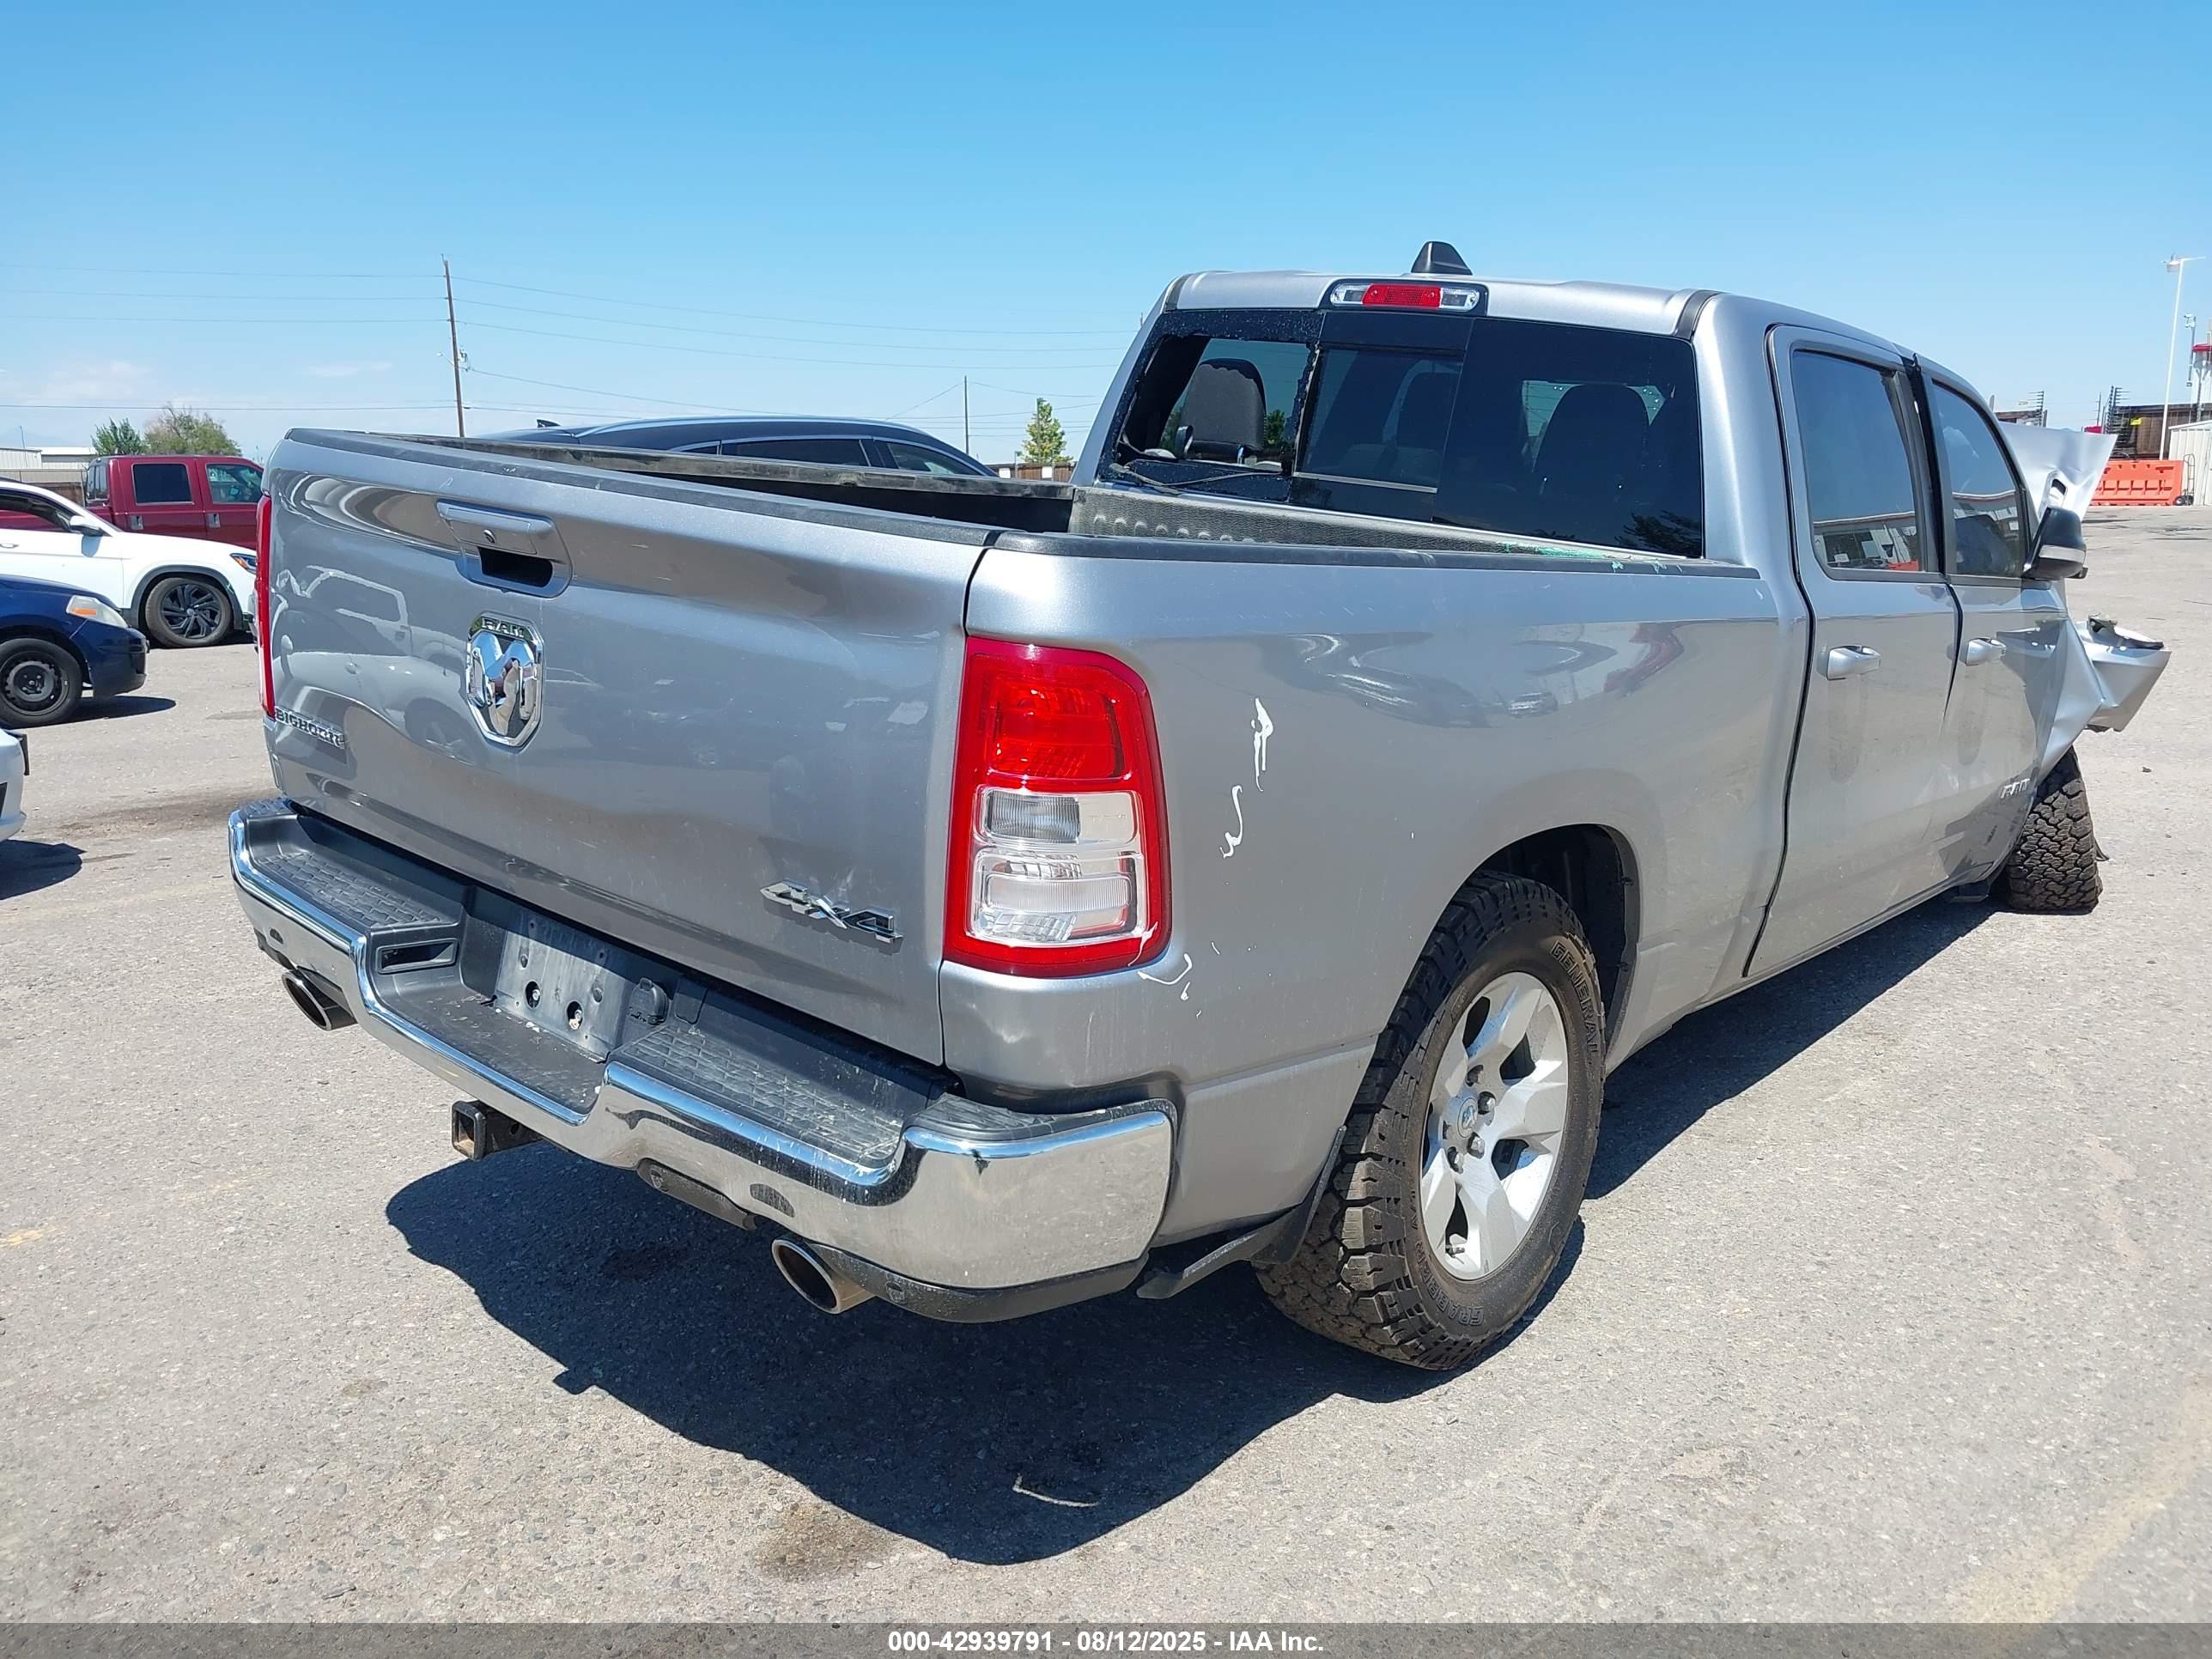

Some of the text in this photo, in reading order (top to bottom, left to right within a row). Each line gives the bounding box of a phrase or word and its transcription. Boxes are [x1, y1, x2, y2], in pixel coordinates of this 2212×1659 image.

[482, 617, 525, 638] RAM
[1549, 940, 1598, 1054] GENERAL
[1414, 1240, 1484, 1326] GRABBER
